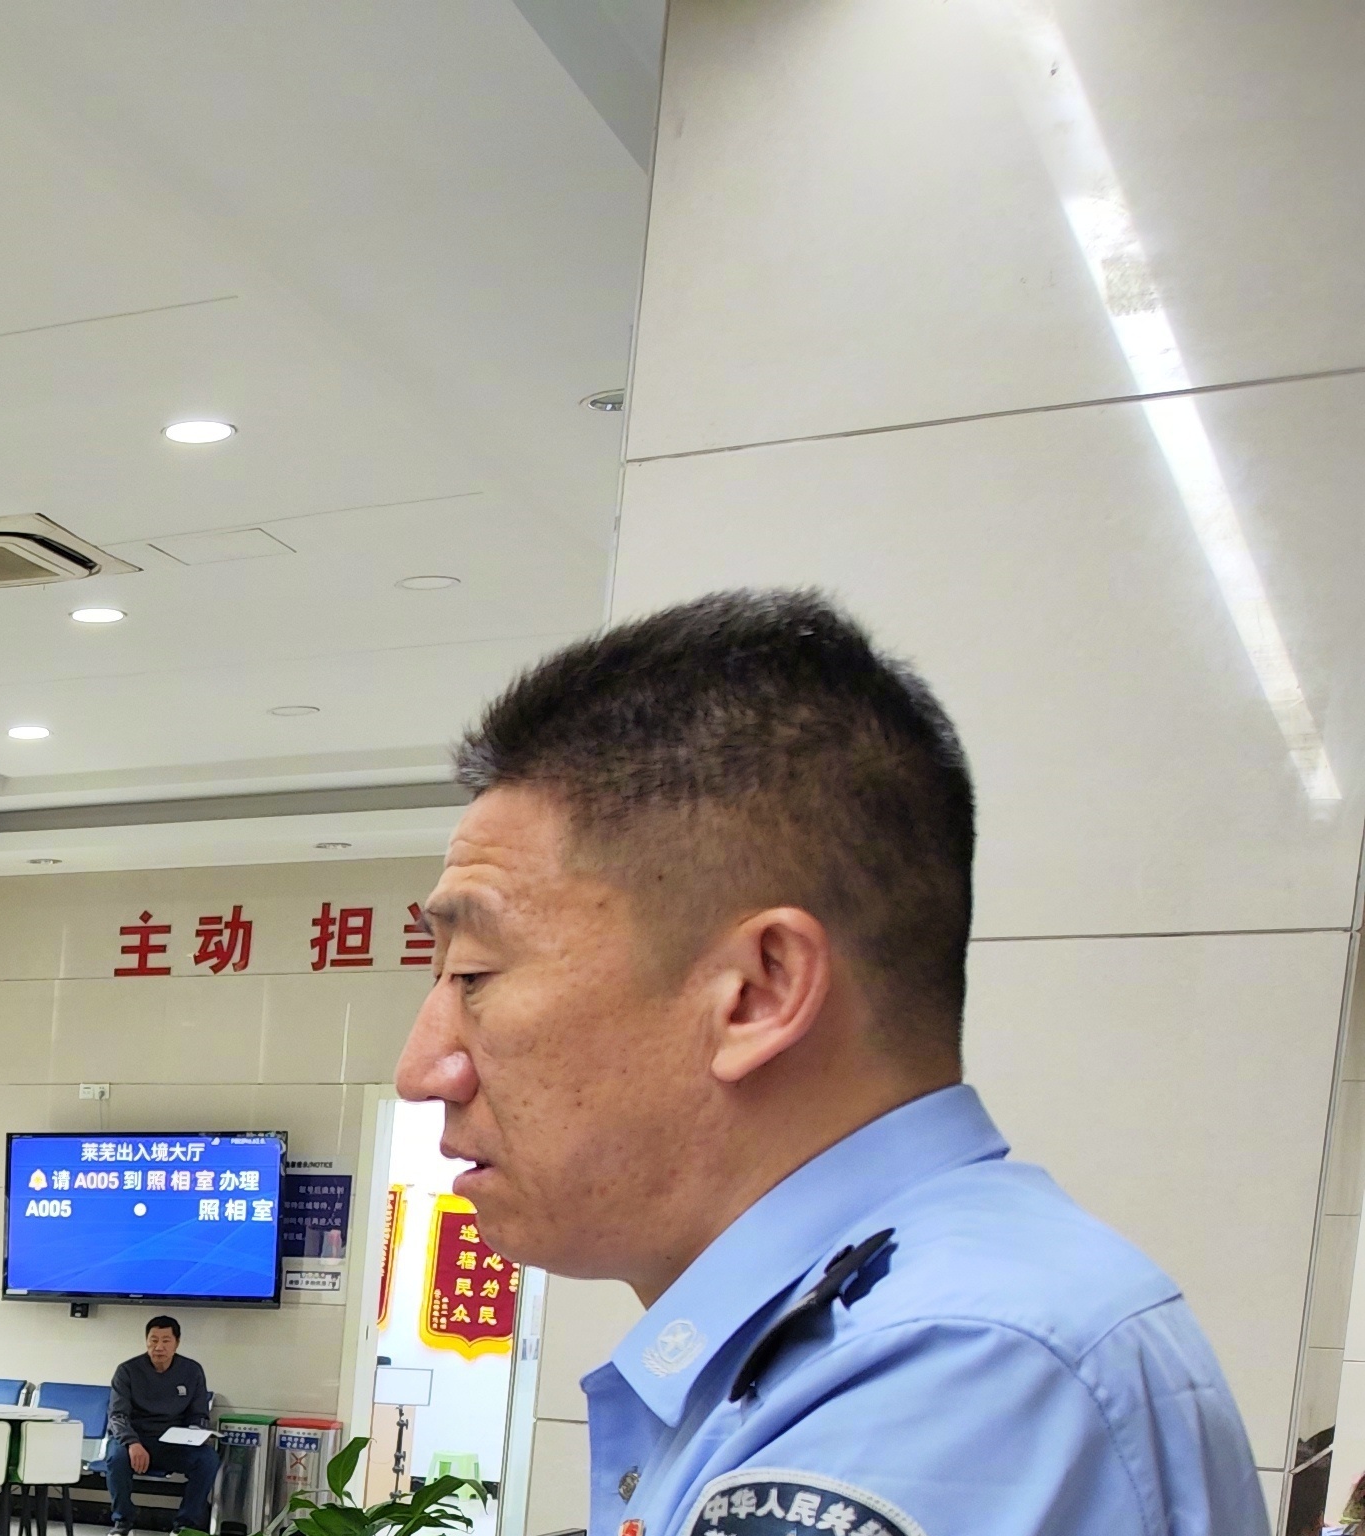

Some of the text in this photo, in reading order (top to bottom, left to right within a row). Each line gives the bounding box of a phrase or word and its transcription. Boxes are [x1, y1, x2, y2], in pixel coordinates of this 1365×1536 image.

[113, 905, 253, 977] 主动
[81, 1142, 205, 1162] 莱芜出入境大厅
[52, 1170, 70, 1190] 请
[74, 1172, 119, 1190] A005
[25, 1199, 273, 1222] A005 照相室
[450, 1223, 480, 1323] 造福民众
